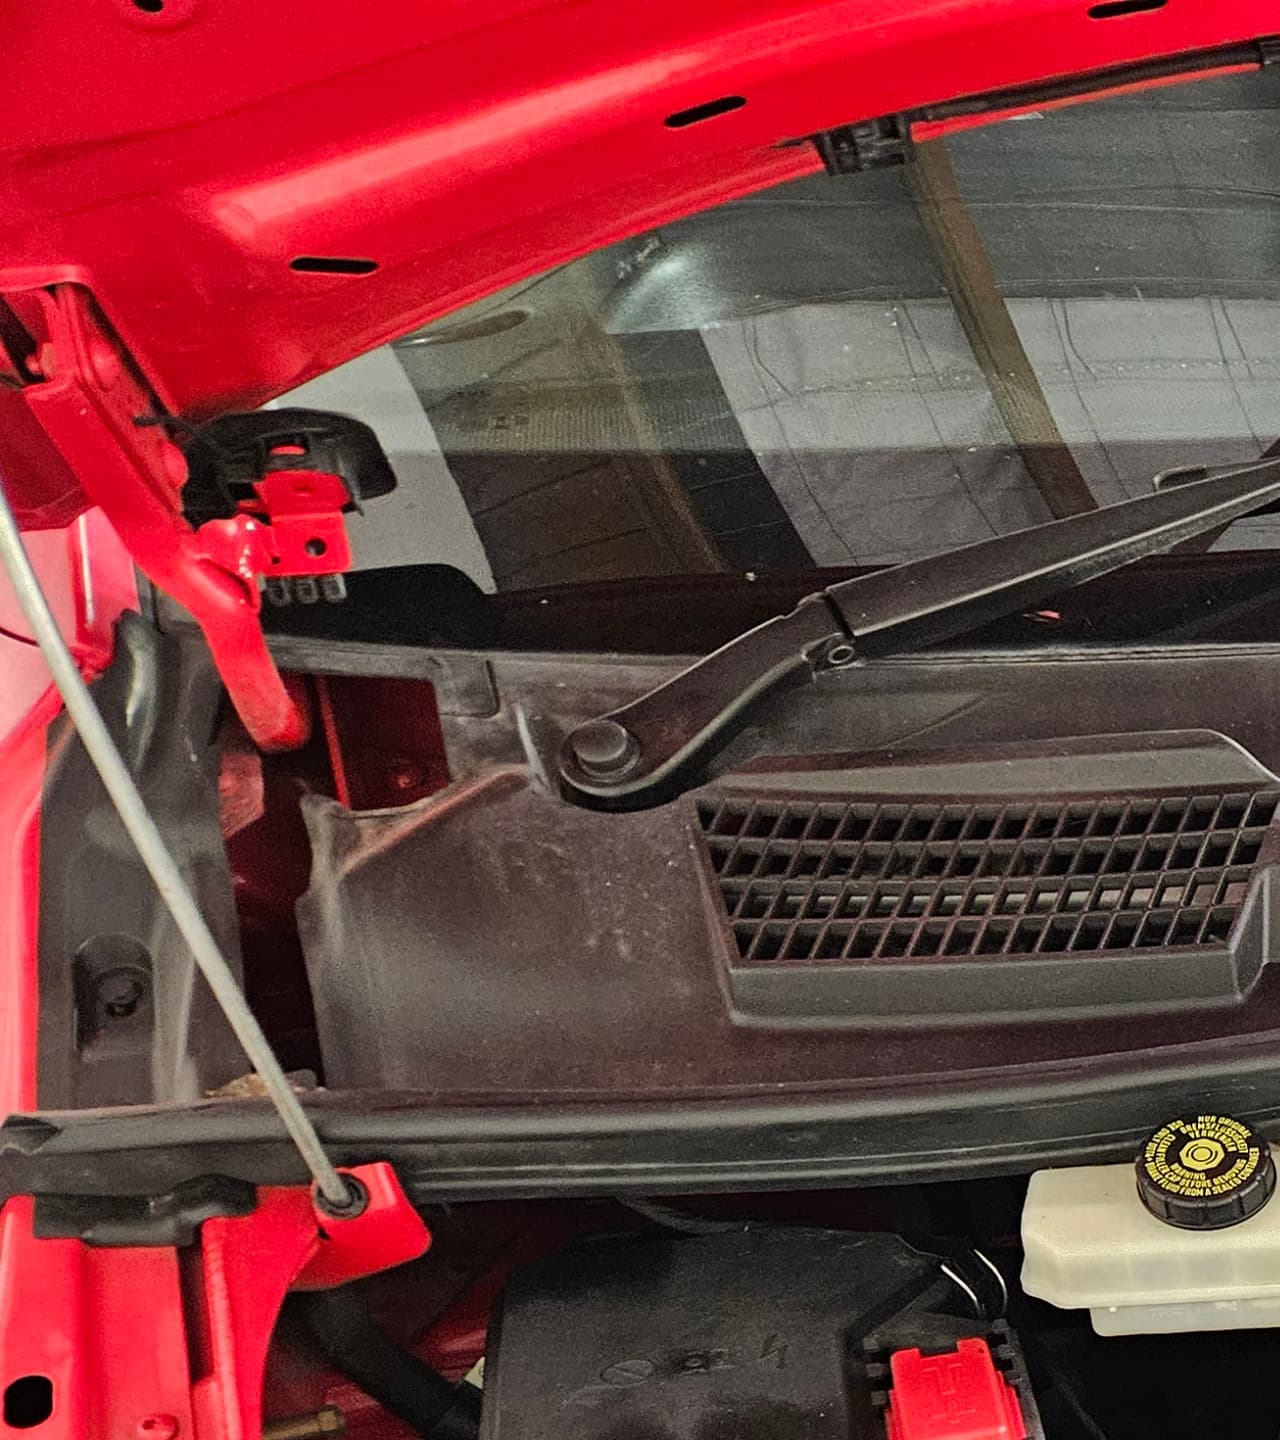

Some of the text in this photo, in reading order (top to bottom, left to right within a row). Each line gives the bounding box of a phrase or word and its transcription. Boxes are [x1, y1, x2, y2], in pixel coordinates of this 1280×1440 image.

[1218, 1117, 1252, 1138] ORIGINAL
[1155, 1152, 1169, 1174] FILLER
[1166, 1171, 1180, 1181] CAP
[1180, 1179, 1212, 1187] BEFORE
[1213, 1159, 1246, 1186] REMOVING
[1170, 1163, 1206, 1180] WARNING
[1180, 1187, 1203, 1196] FROM
[1205, 1188, 1212, 1196] A
[1213, 1179, 1241, 1194] SEALED
